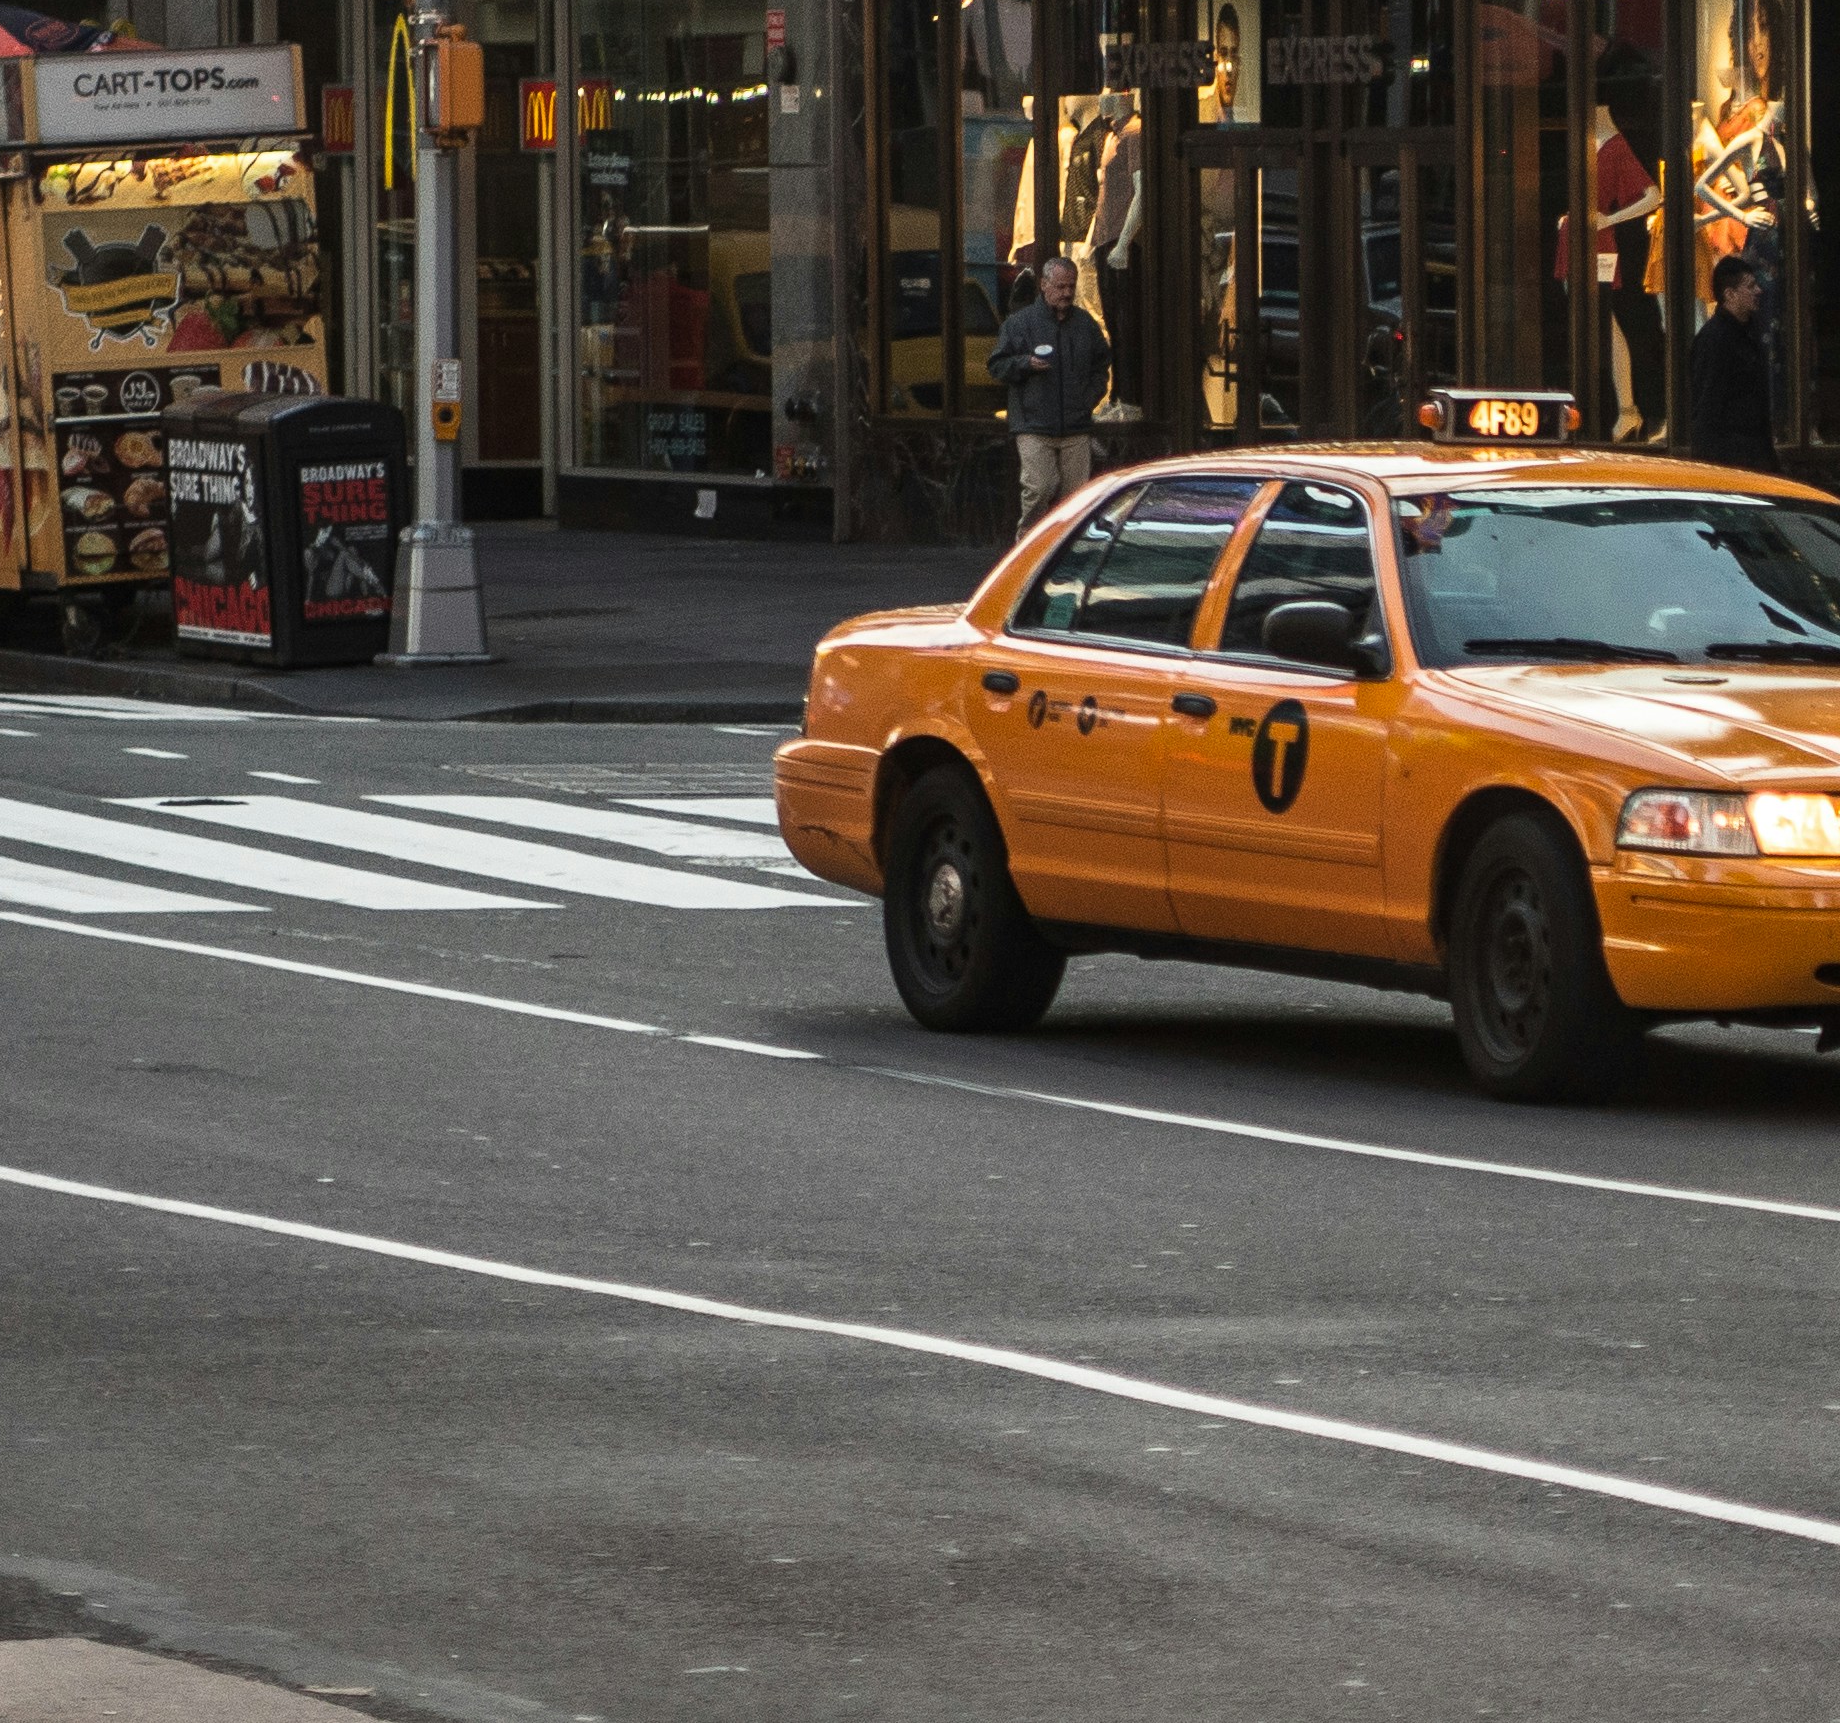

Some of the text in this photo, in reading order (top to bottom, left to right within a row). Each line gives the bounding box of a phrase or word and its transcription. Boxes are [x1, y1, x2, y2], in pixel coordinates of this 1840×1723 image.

[1267, 34, 1382, 85] EXPRESS
[73, 65, 259, 97] CART-TOPS.com
[1468, 399, 1539, 436] 4F89
[168, 438, 246, 474] BROADWAY'S
[301, 462, 385, 483] BROADWAY'S
[169, 470, 241, 505] SURE THING
[303, 479, 386, 506] SURE
[173, 575, 270, 635] CHICAGO
[1230, 717, 1256, 738] NYC
